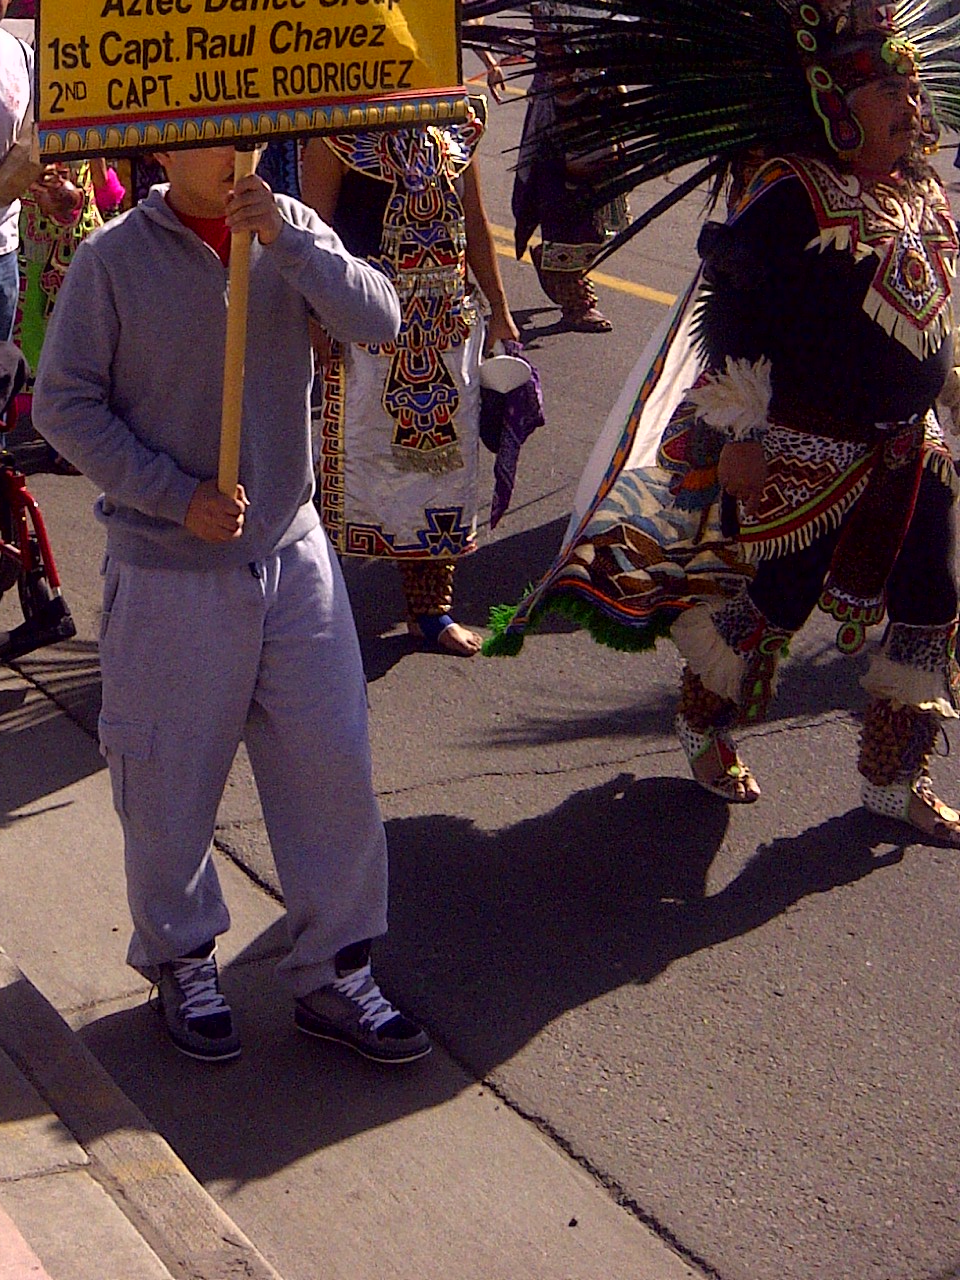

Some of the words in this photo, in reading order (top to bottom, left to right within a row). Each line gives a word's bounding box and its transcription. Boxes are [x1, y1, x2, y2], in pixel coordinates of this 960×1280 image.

[49, 37, 91, 70] 1st
[99, 29, 180, 70] Capt.
[186, 24, 257, 61] Raul
[269, 20, 386, 54] Chavez
[49, 80, 88, 113] 2ND
[107, 74, 180, 110] CAPT.
[189, 67, 259, 103] JULIE
[273, 59, 414, 98] RODRIGUEZ
